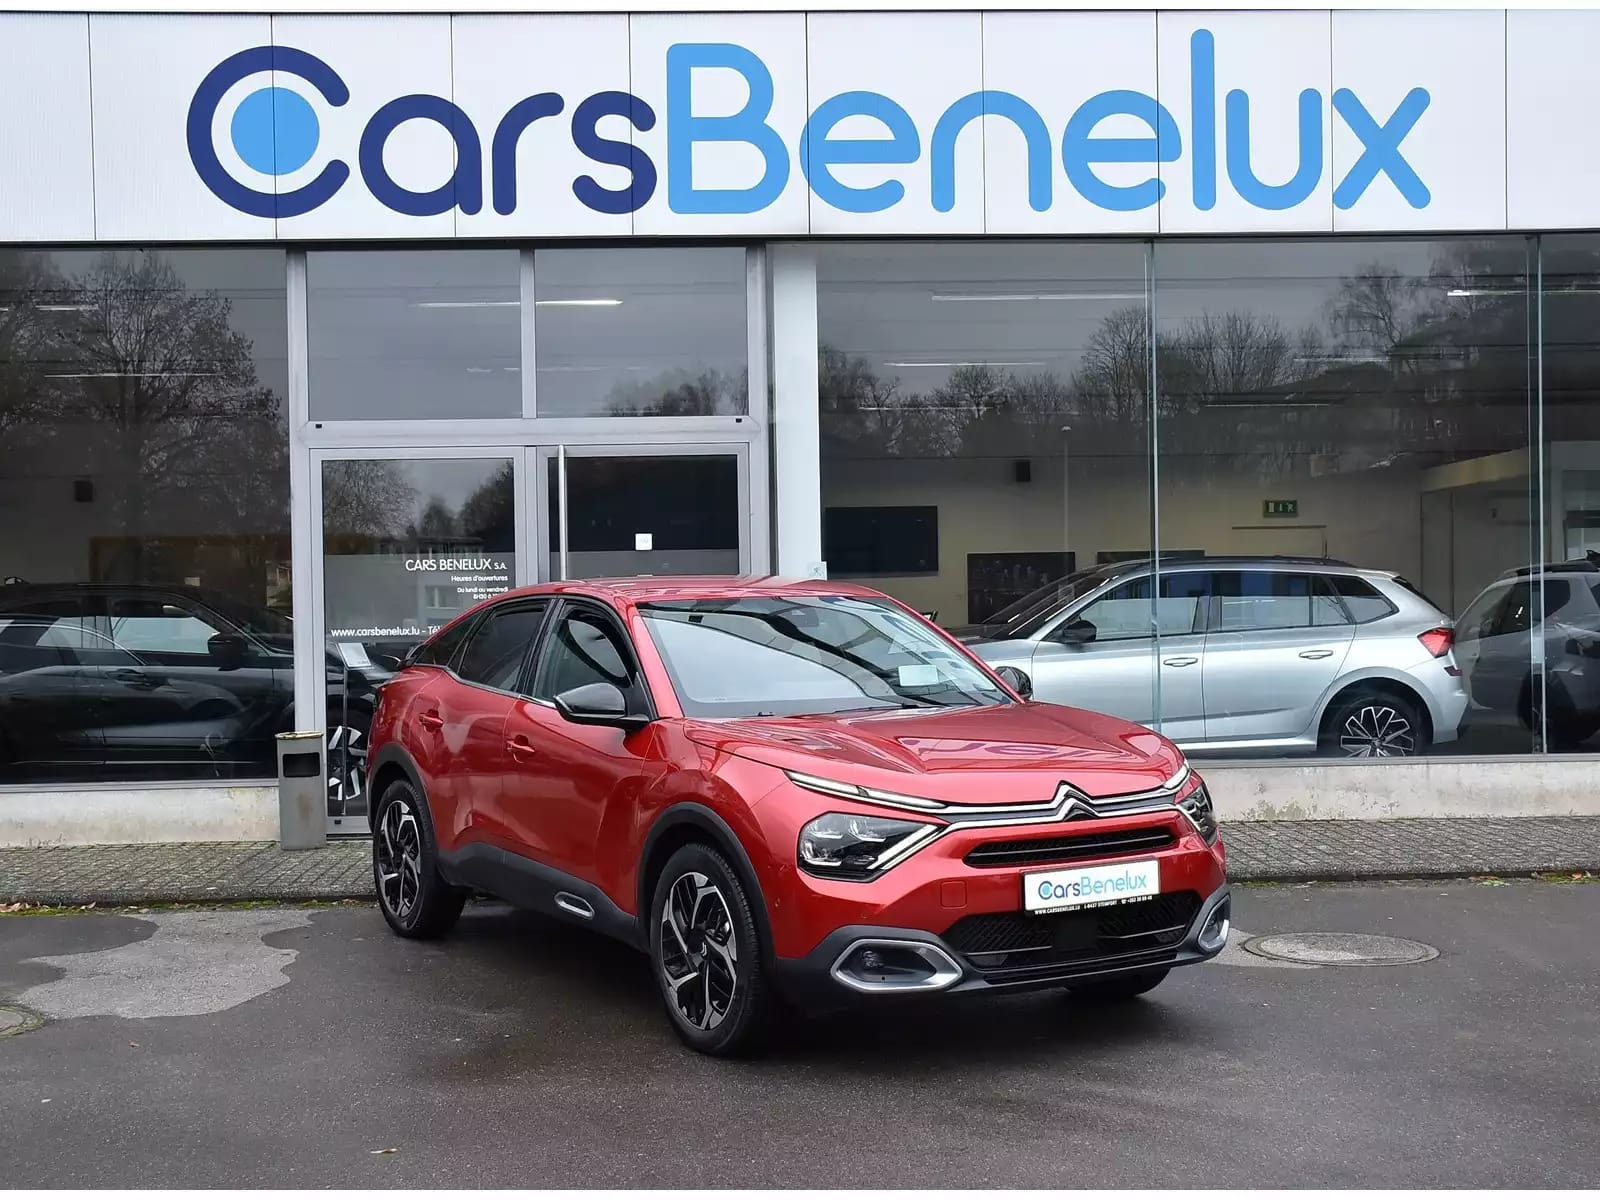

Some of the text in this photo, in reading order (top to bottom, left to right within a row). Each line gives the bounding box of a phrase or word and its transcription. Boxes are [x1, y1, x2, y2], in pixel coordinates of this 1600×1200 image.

[187, 29, 1431, 218] CarsBenelux
[405, 559, 437, 571] CARS
[439, 558, 492, 571] BENELUX
[331, 626, 420, 637] www.carsbenelux.lu
[1038, 870, 1147, 900] CarsBenelux
